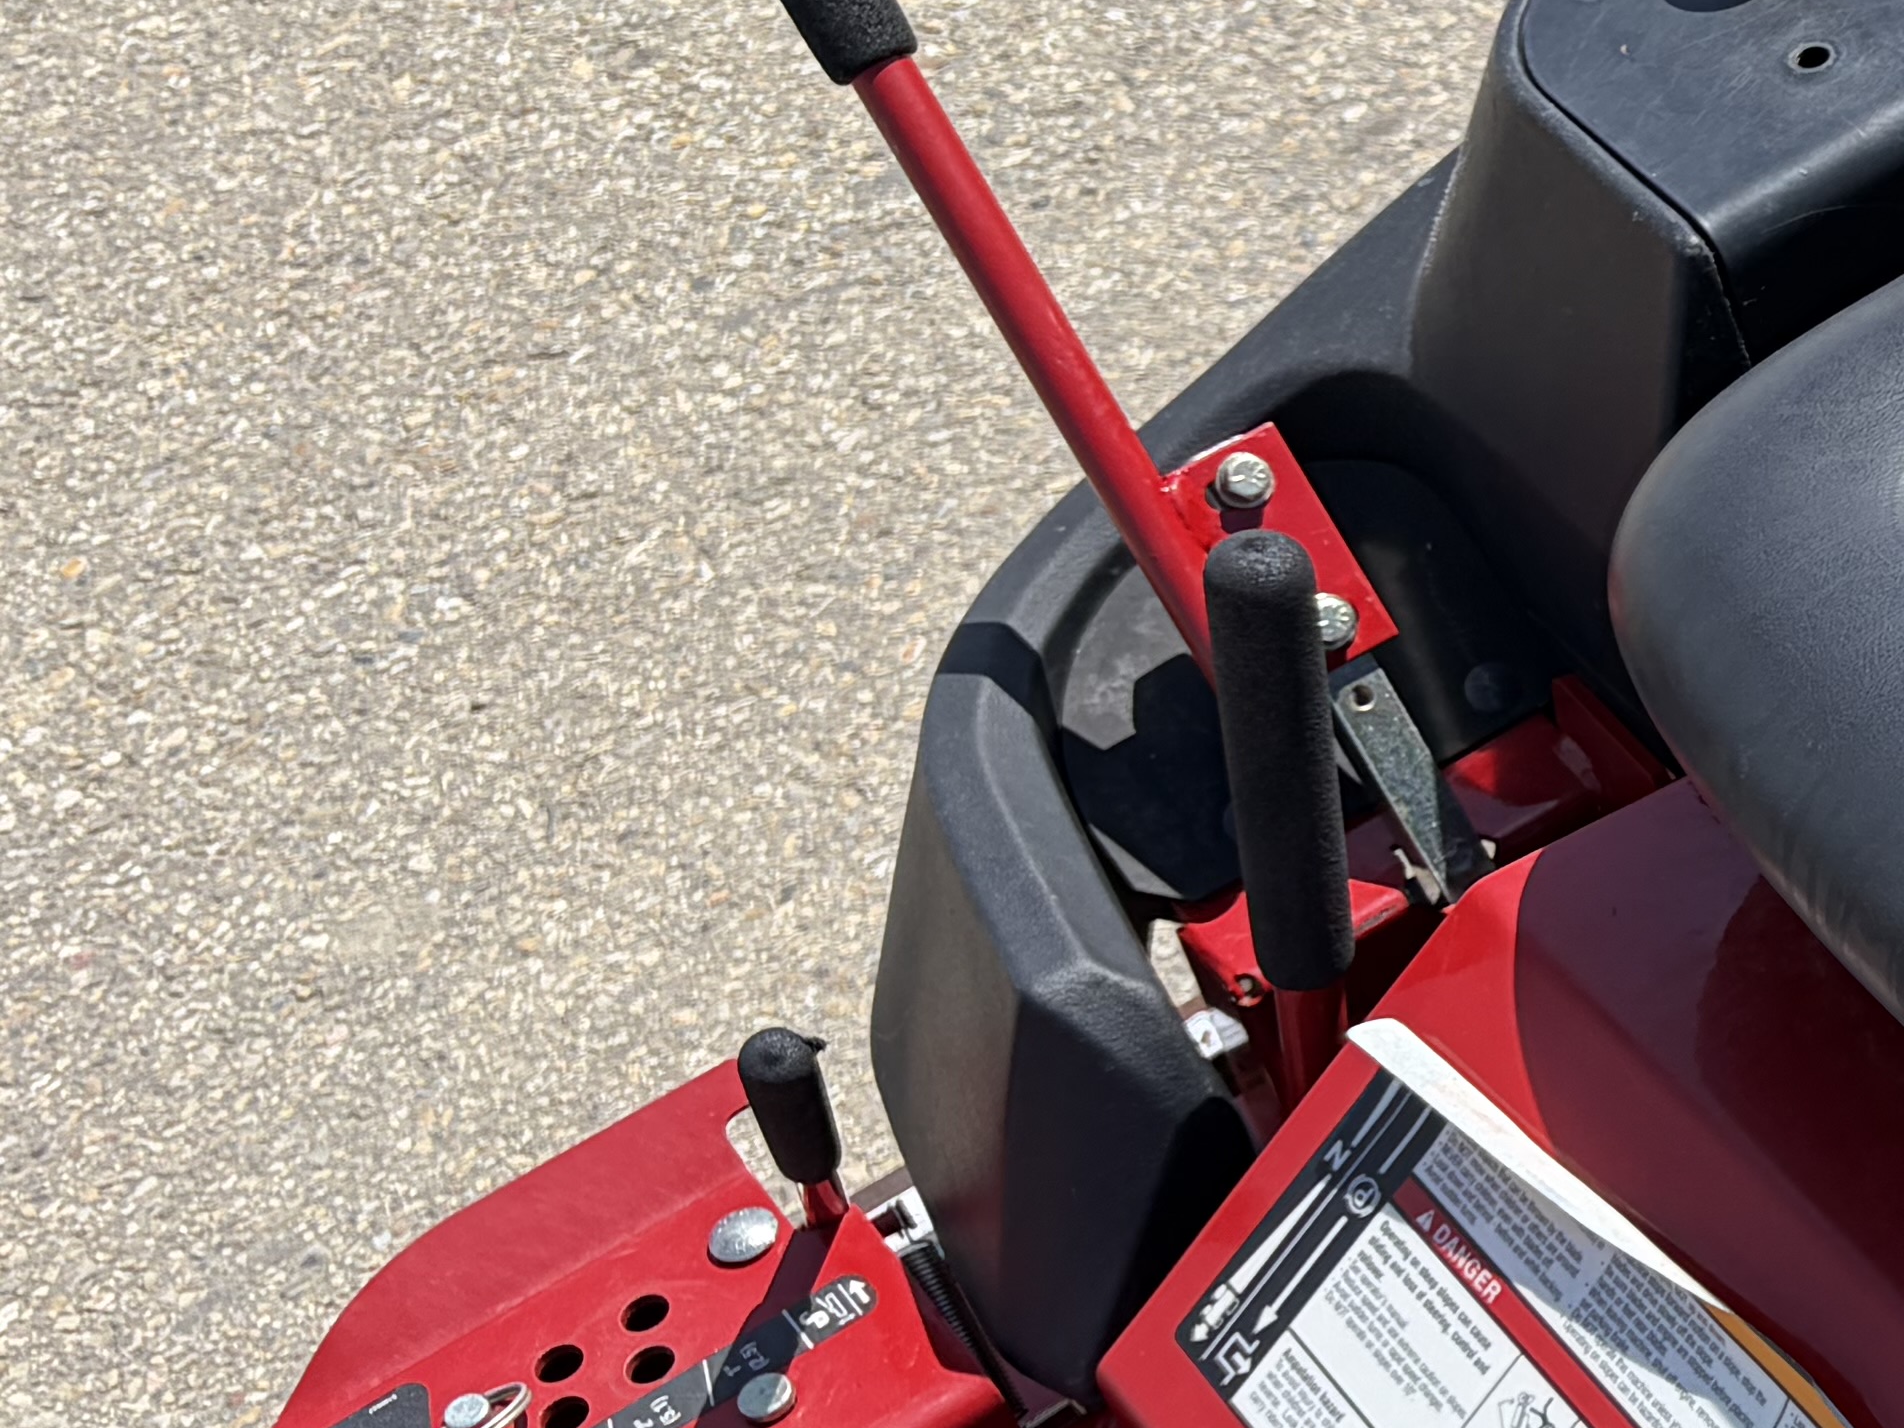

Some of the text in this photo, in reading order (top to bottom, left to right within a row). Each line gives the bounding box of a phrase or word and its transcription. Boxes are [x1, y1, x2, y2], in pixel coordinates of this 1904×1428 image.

[1323, 1139, 1352, 1172] N
[1433, 1224, 1501, 1303] DANGER
[739, 1341, 768, 1370] (2.5)
[650, 1395, 681, 1425] (5.1)
